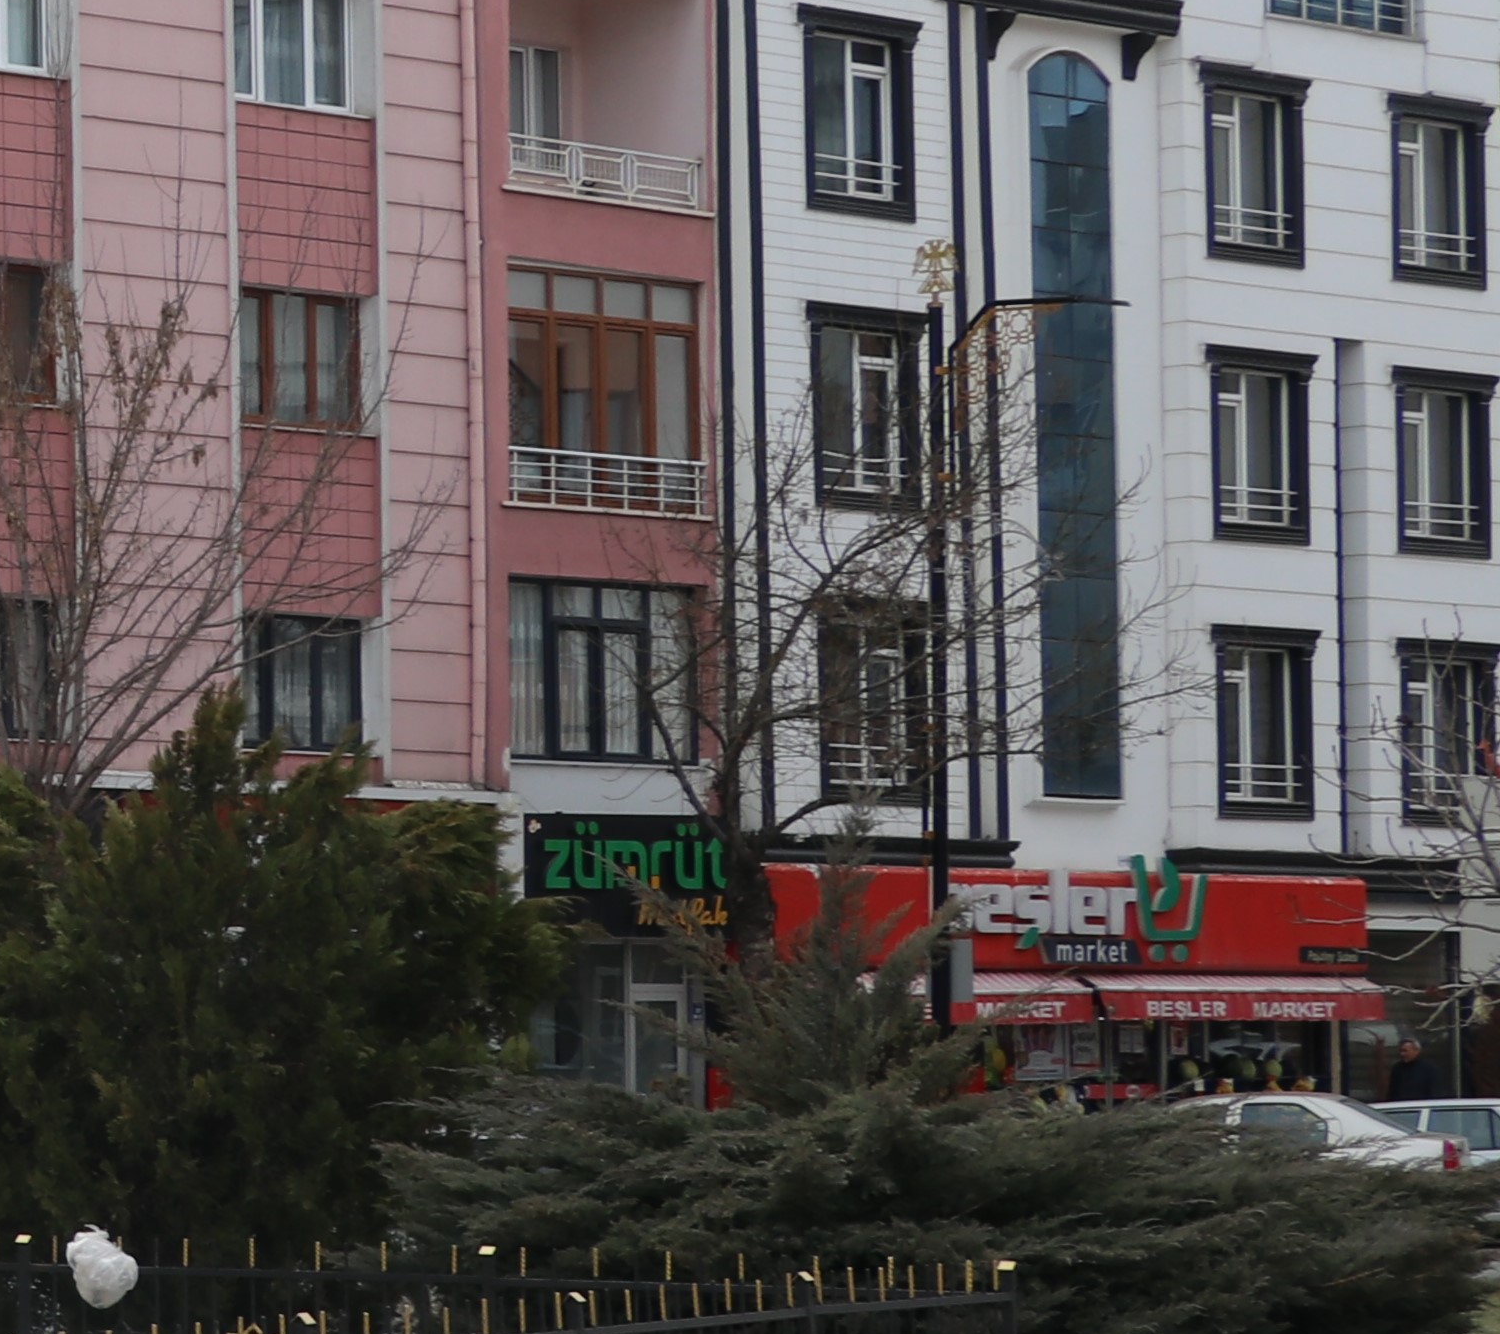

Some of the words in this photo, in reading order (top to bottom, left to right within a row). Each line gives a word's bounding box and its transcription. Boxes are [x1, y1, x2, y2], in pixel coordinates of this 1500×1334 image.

[1055, 940, 1128, 963] market
[1146, 1000, 1227, 1020] BEŞLER
[1252, 1002, 1337, 1018] MARKET
